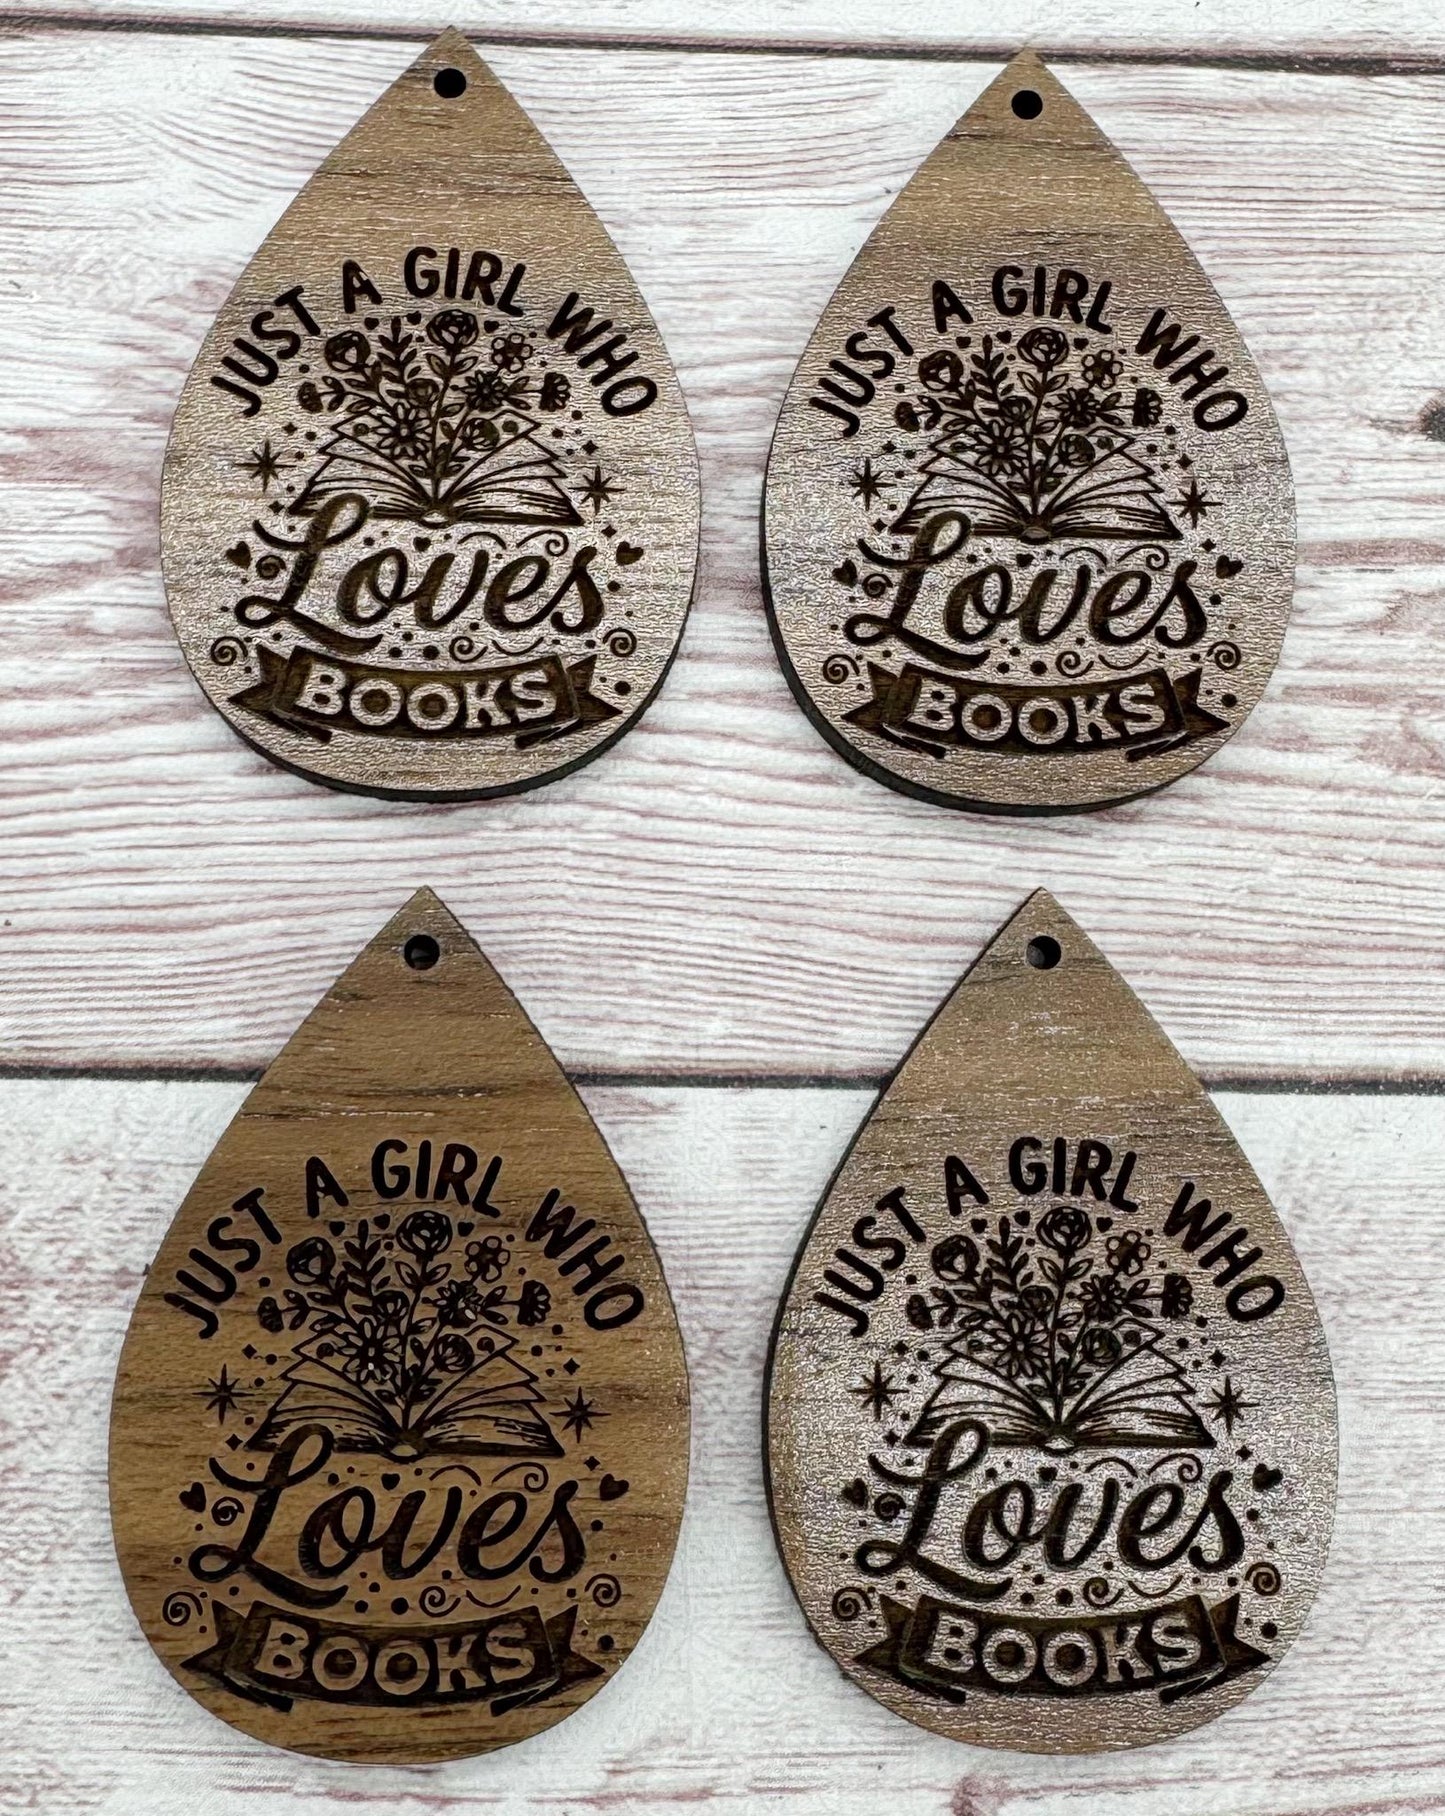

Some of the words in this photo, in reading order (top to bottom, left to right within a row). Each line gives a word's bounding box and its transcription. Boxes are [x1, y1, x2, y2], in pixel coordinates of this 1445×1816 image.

[211, 287, 321, 417] JUST
[343, 260, 382, 314] A
[404, 247, 525, 316] GIRL
[548, 293, 657, 416] WHO
[810, 307, 915, 437] JUST
[932, 281, 973, 333] A
[992, 266, 1112, 334] GIRL
[1136, 309, 1248, 432] WHO
[235, 493, 603, 654] Loves
[843, 511, 1206, 670] Loves
[297, 666, 556, 730] BOOKS
[908, 684, 1167, 744] BOOKS
[164, 1188, 282, 1339] JUST
[306, 1157, 348, 1217] A
[371, 1140, 502, 1217] GIRL
[526, 1189, 644, 1331] WHO
[815, 1188, 926, 1337] JUST
[944, 1156, 989, 1216] A
[1009, 1137, 1138, 1212] GIRL
[1164, 1183, 1285, 1322] WHO
[189, 1424, 585, 1607] Loves
[855, 1420, 1245, 1600] Loves
[256, 1623, 535, 1694] BOOKS
[926, 1614, 1202, 1686] BOOKS
